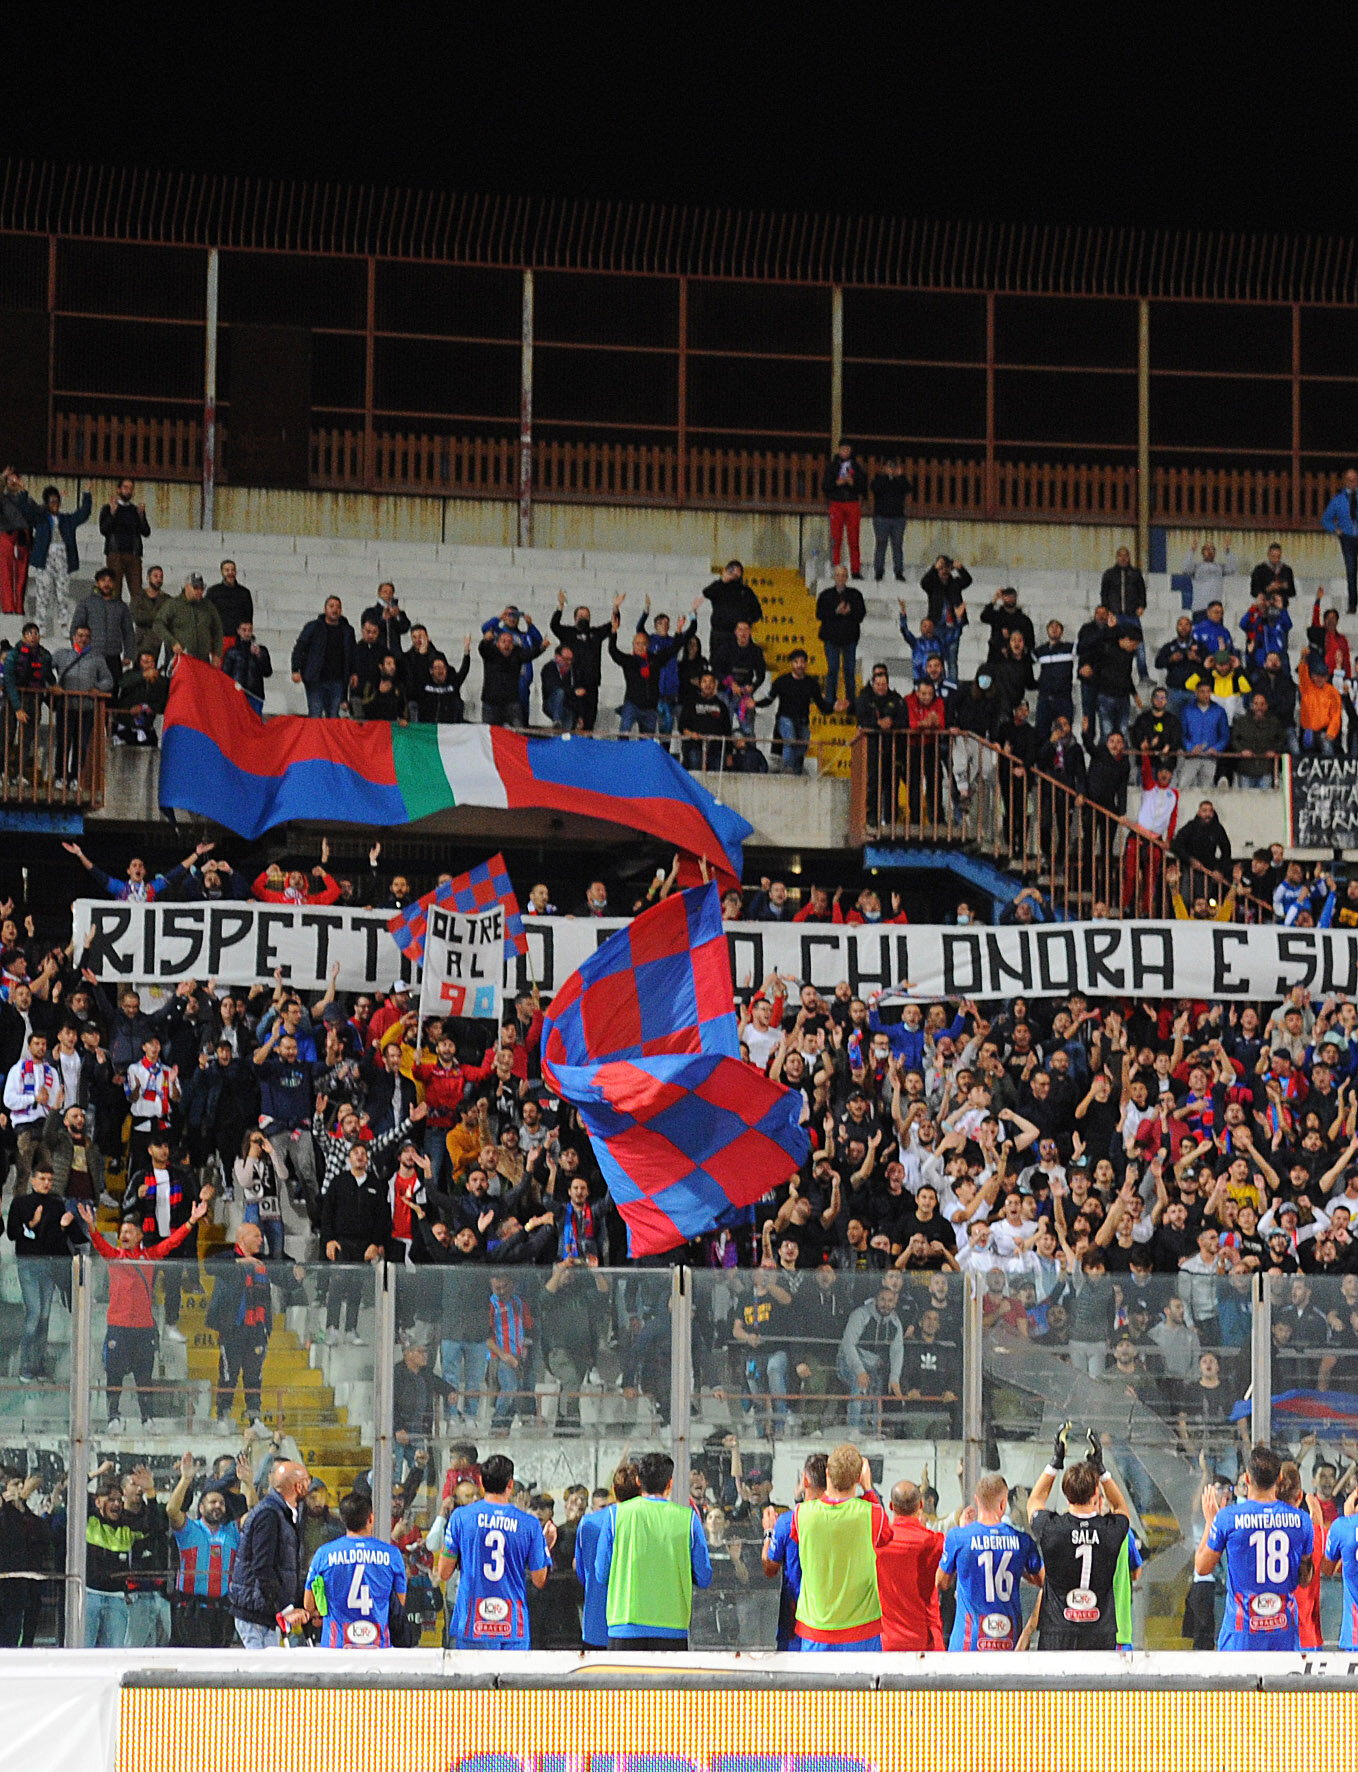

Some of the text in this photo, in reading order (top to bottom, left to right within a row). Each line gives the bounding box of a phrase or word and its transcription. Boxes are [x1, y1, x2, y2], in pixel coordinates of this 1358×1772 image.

[432, 911, 501, 944] OLTRE
[447, 950, 484, 978] AL
[800, 934, 907, 991] CHI
[943, 927, 1174, 996] ONORA
[1213, 930, 1249, 993] E
[440, 982, 495, 1016] 90
[477, 1513, 518, 1533] CLAITON
[1071, 1529, 1100, 1545] SALA
[1234, 1513, 1301, 1530] MONTEAGUDO
[328, 1550, 390, 1567] MALDONADO
[483, 1529, 506, 1582] 3
[970, 1535, 1020, 1551] ALBERTINI
[1249, 1529, 1290, 1584] 18
[977, 1551, 1014, 1603] 16
[1075, 1544, 1093, 1590] 1
[347, 1564, 373, 1616] 4
